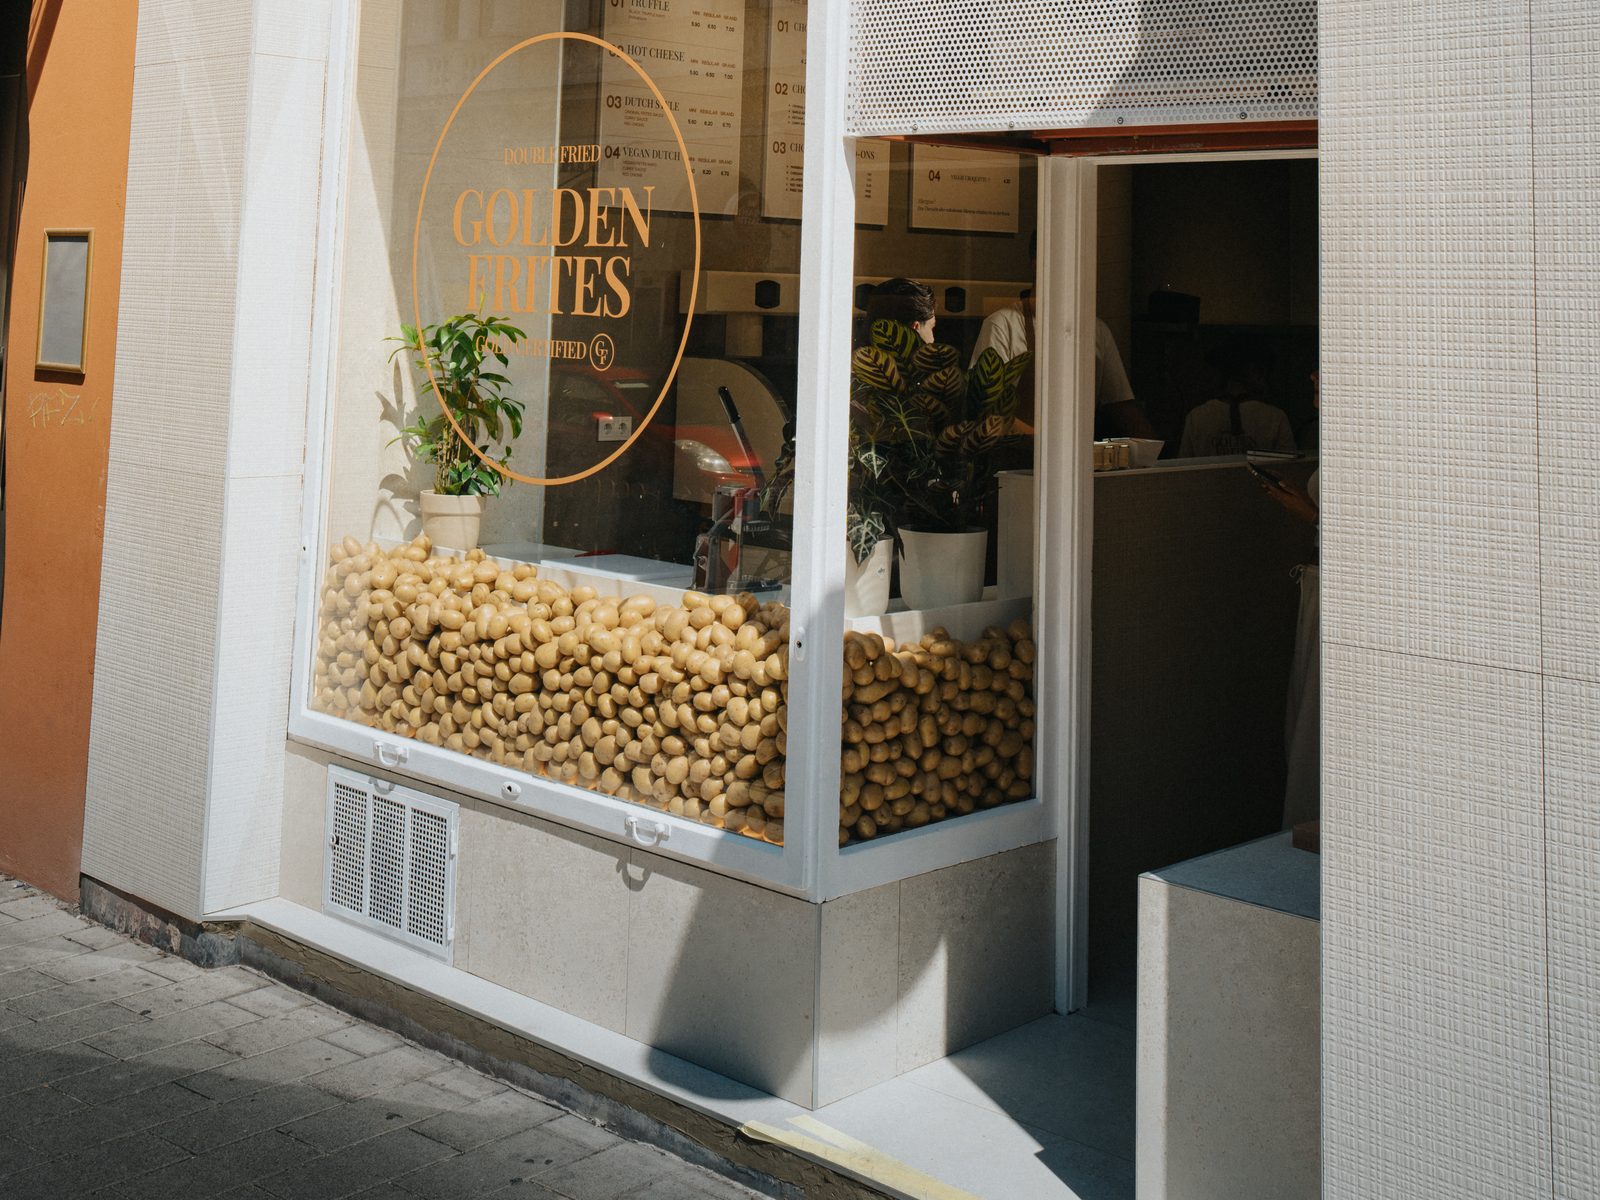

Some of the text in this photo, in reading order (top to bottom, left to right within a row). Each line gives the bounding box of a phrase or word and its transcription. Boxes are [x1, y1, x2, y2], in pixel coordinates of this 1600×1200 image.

[777, 19, 789, 33] 01
[627, 44, 648, 57] HOT
[649, 48, 685, 62] CHEESE
[775, 82, 788, 96] 02
[606, 95, 622, 109] 03
[624, 96, 654, 109] DUTCH
[559, 144, 602, 164] FRIED
[604, 145, 680, 161] 04 VEGAN DUTCH
[772, 141, 786, 154] 03
[856, 150, 875, 160] -ONS
[928, 169, 941, 183] 04
[453, 186, 656, 248] GOLDEN
[465, 255, 632, 319] FRITES
